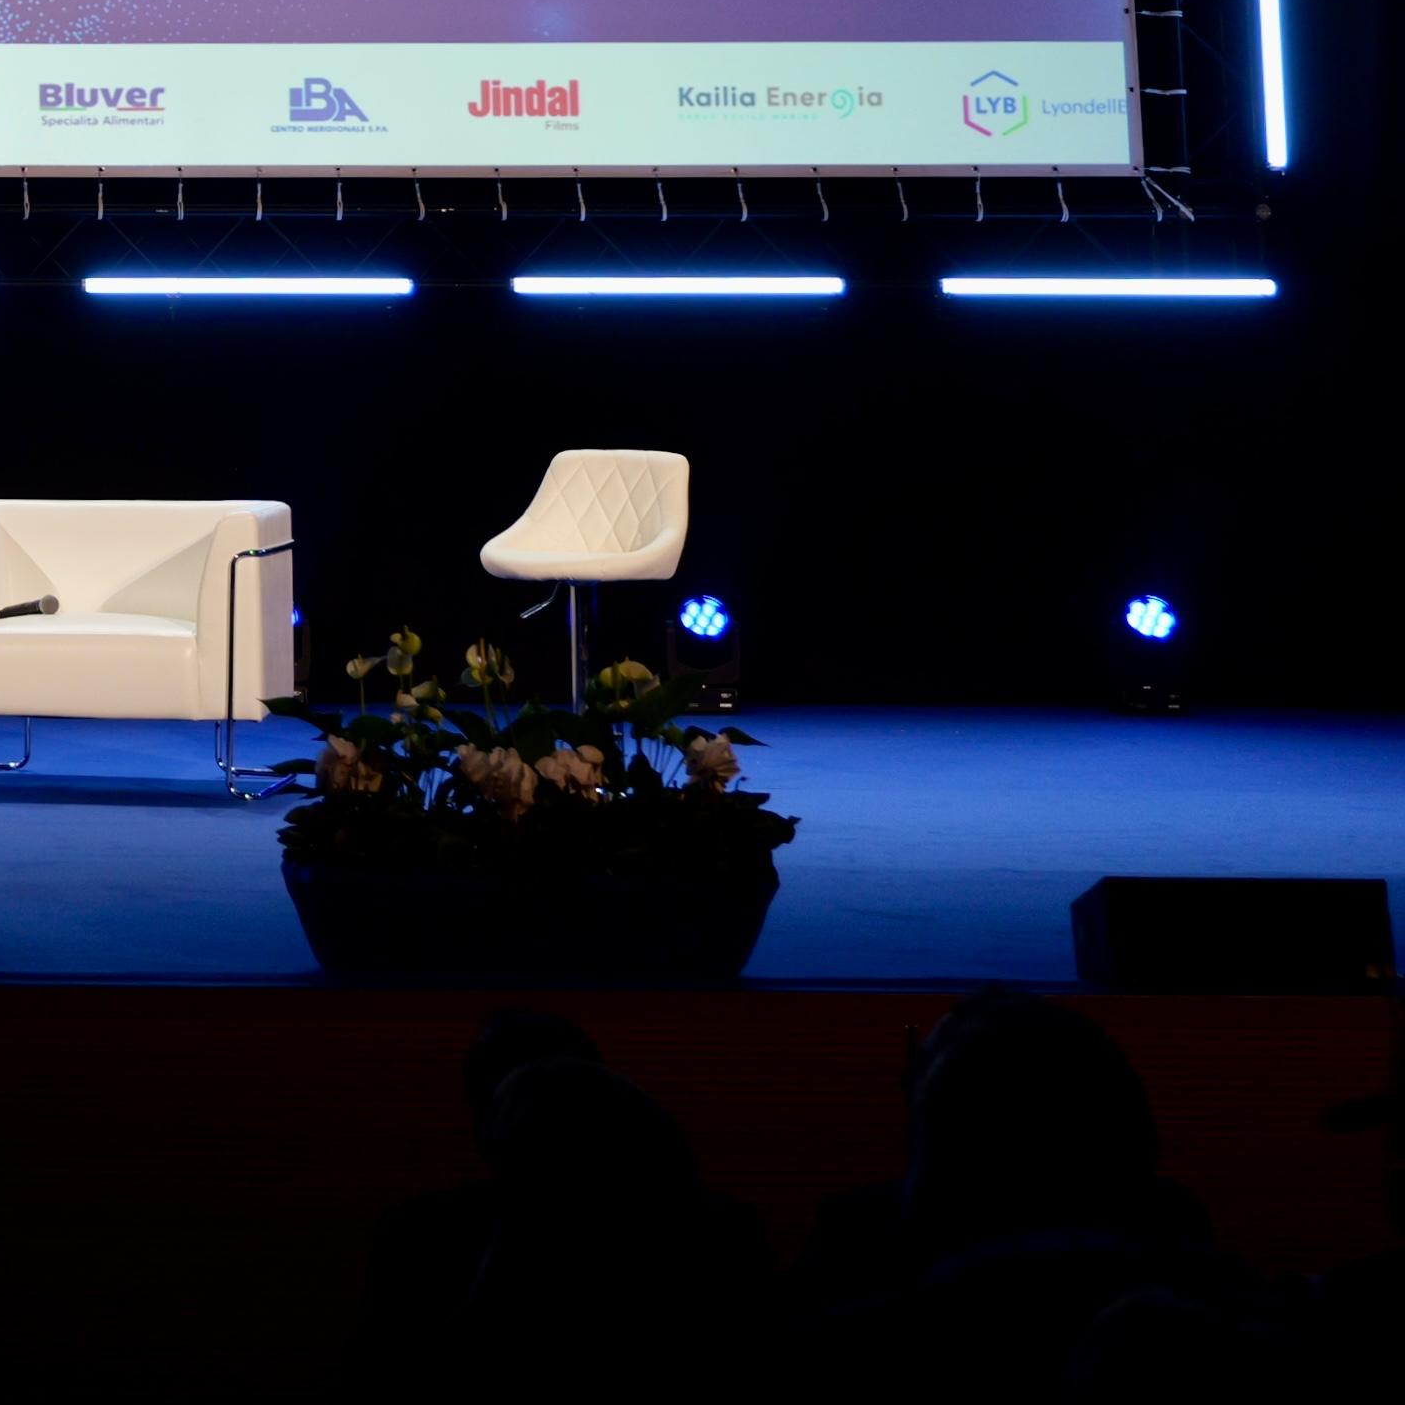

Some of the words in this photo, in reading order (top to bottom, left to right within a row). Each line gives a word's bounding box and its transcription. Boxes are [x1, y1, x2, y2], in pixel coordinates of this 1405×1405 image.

[39, 83, 165, 107] Bluver
[467, 80, 579, 117] Jindal
[678, 86, 755, 108] Kailia
[766, 86, 883, 120] Energia
[975, 96, 1017, 114] LYB
[102, 115, 164, 126] Alimentari
[545, 120, 580, 131] Films
